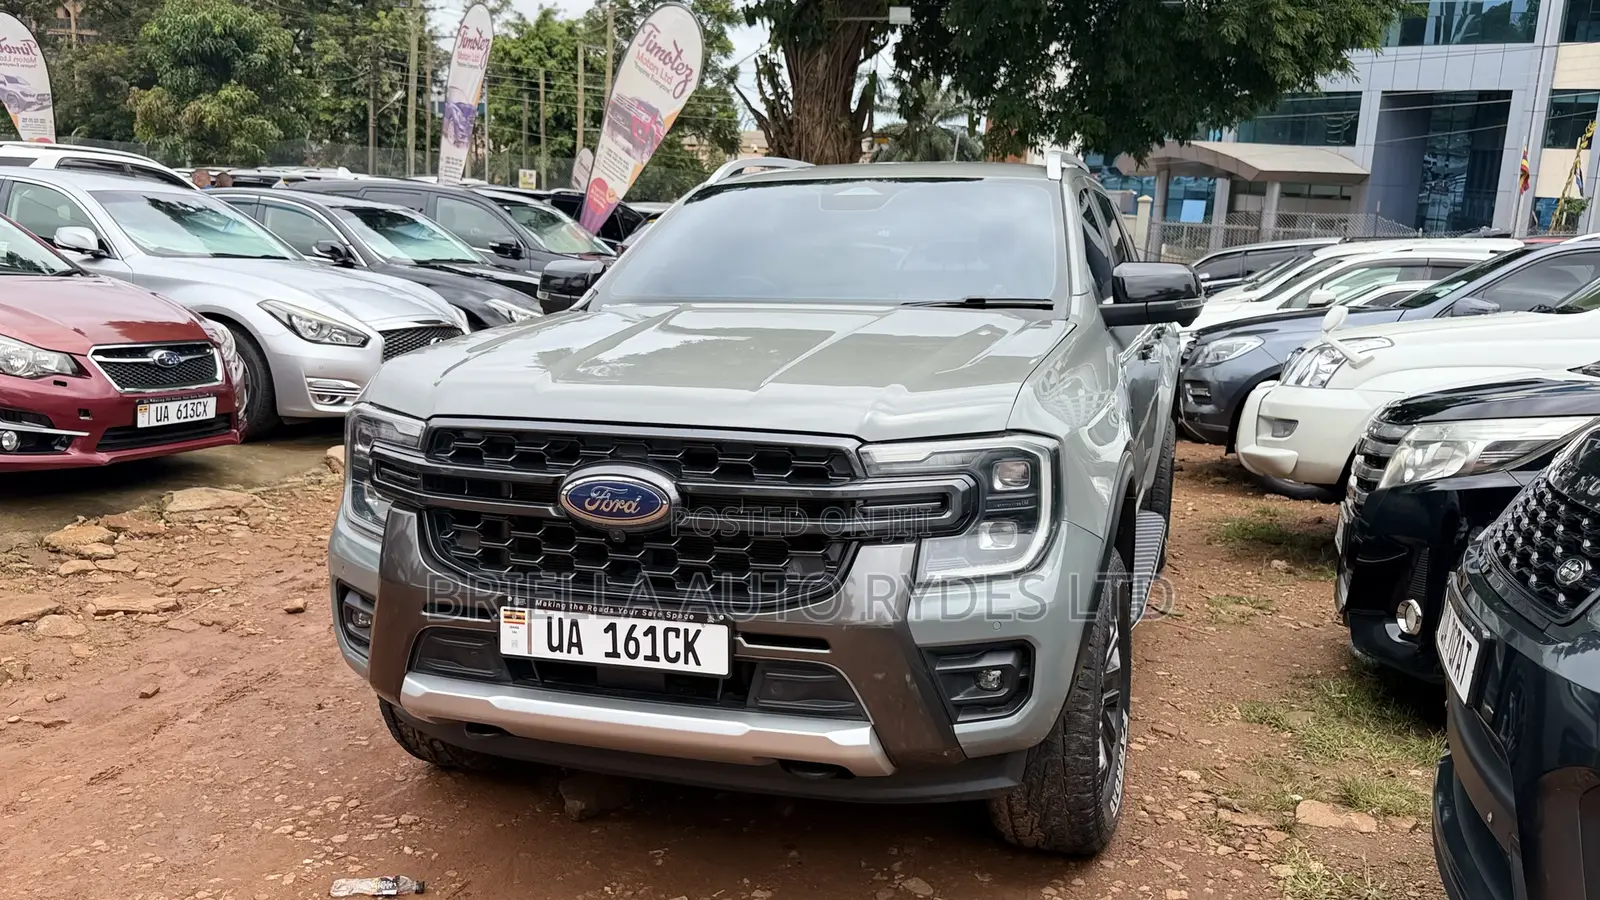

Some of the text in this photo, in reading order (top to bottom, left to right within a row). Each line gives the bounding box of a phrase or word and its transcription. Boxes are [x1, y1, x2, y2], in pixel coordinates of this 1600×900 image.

[155, 401, 208, 422] UA 613CX
[584, 485, 643, 514] Ford
[534, 600, 566, 610] Making
[569, 603, 584, 611] the
[587, 605, 614, 614] Roads
[618, 607, 639, 616] Your
[546, 615, 702, 667] UA 161CK
